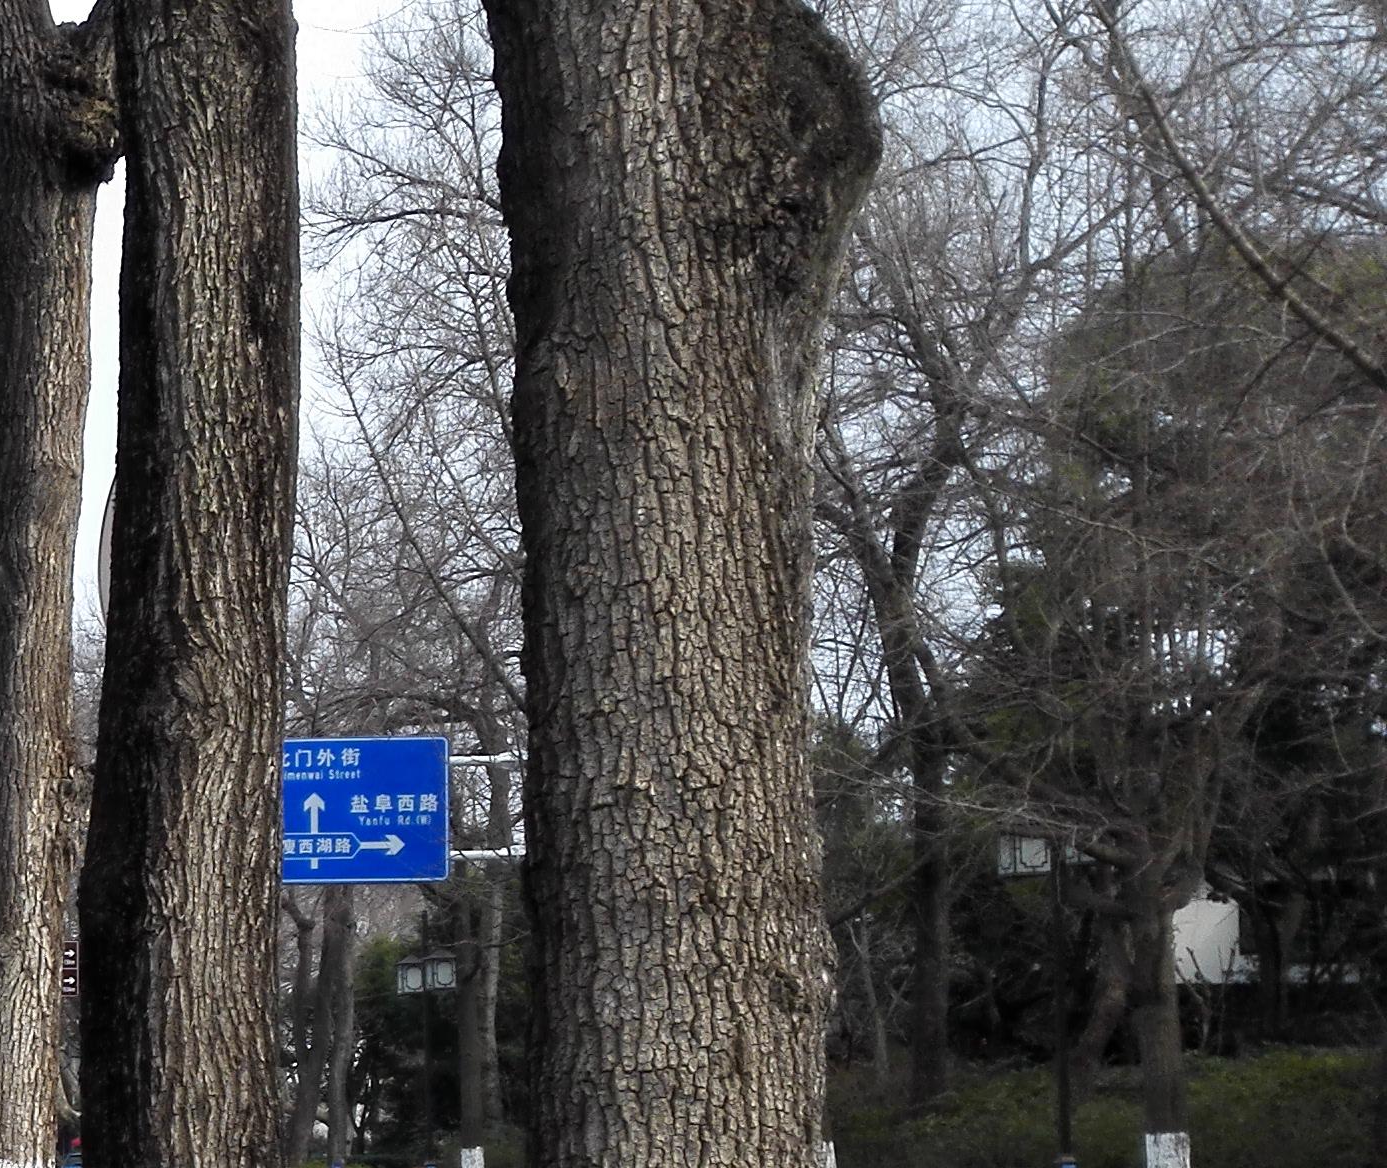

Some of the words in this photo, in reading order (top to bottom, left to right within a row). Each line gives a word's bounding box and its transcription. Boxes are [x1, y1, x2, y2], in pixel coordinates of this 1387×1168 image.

[283, 769, 324, 780] imenwai
[328, 769, 361, 780] Street
[350, 793, 439, 813] 盐阜西路
[358, 815, 391, 826] Yanfu
